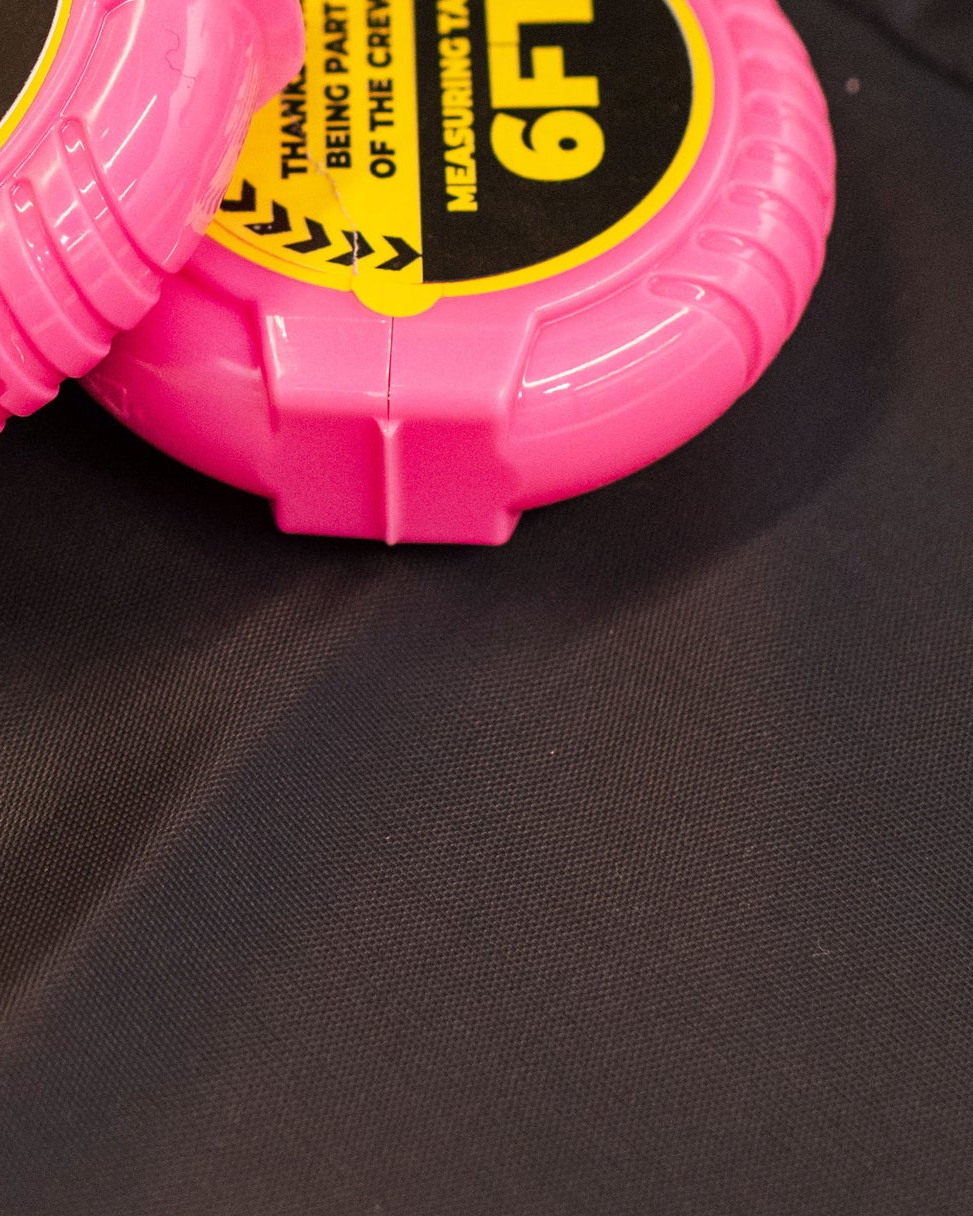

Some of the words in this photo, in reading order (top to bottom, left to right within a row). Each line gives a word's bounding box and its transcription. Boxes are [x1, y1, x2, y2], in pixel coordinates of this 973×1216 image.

[323, 3, 348, 70] PART
[280, 64, 308, 180] THANK
[324, 84, 352, 169] BEING
[368, 78, 394, 132] THE
[438, 37, 478, 212] MEASURING
[369, 140, 397, 179] OF
